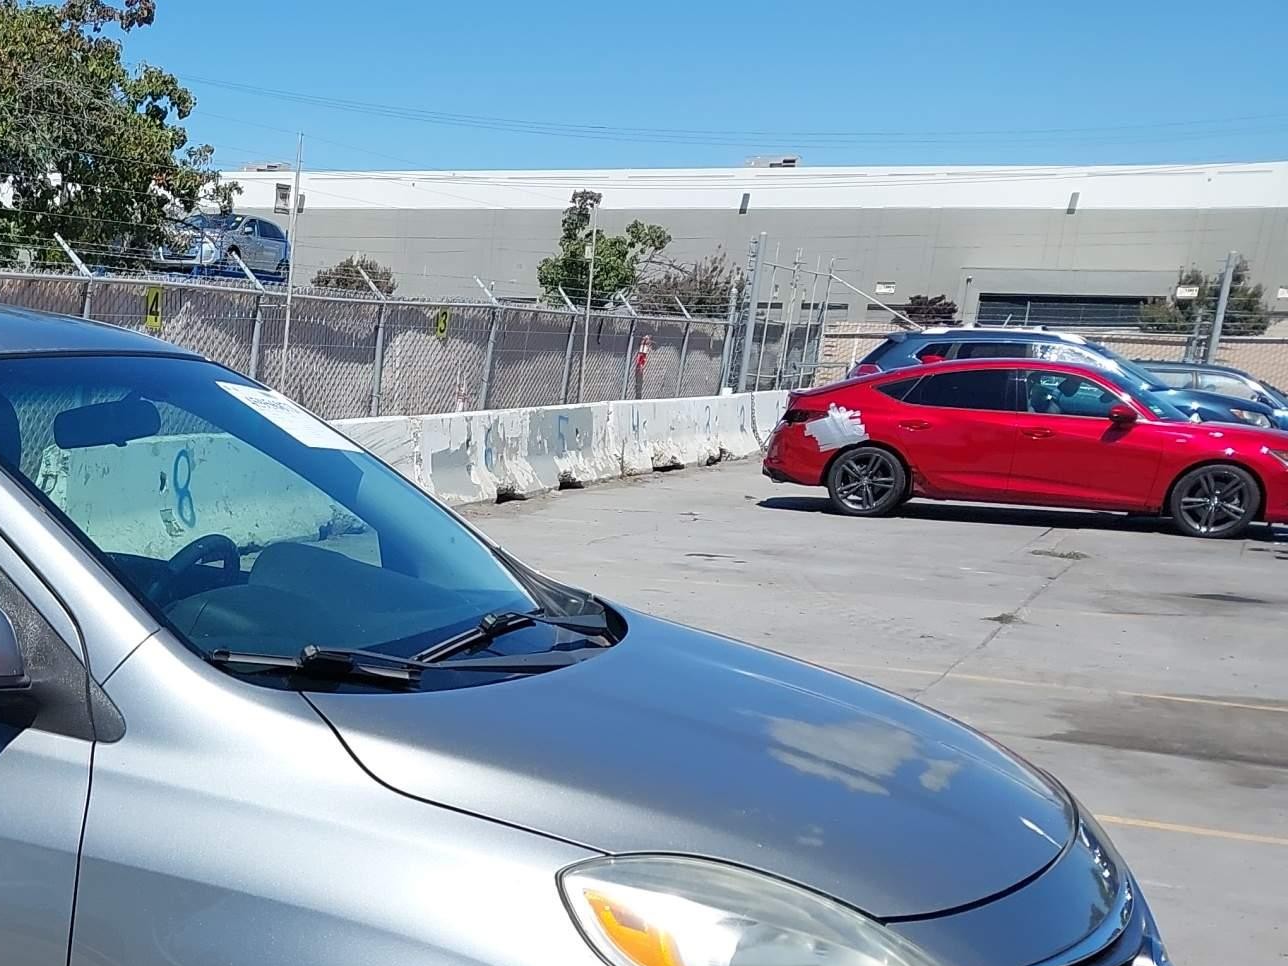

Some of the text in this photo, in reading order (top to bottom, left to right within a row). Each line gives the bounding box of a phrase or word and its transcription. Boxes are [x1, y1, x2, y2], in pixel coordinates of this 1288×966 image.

[149, 291, 160, 323] 4
[439, 311, 448, 334] 3
[173, 449, 196, 528] 8
